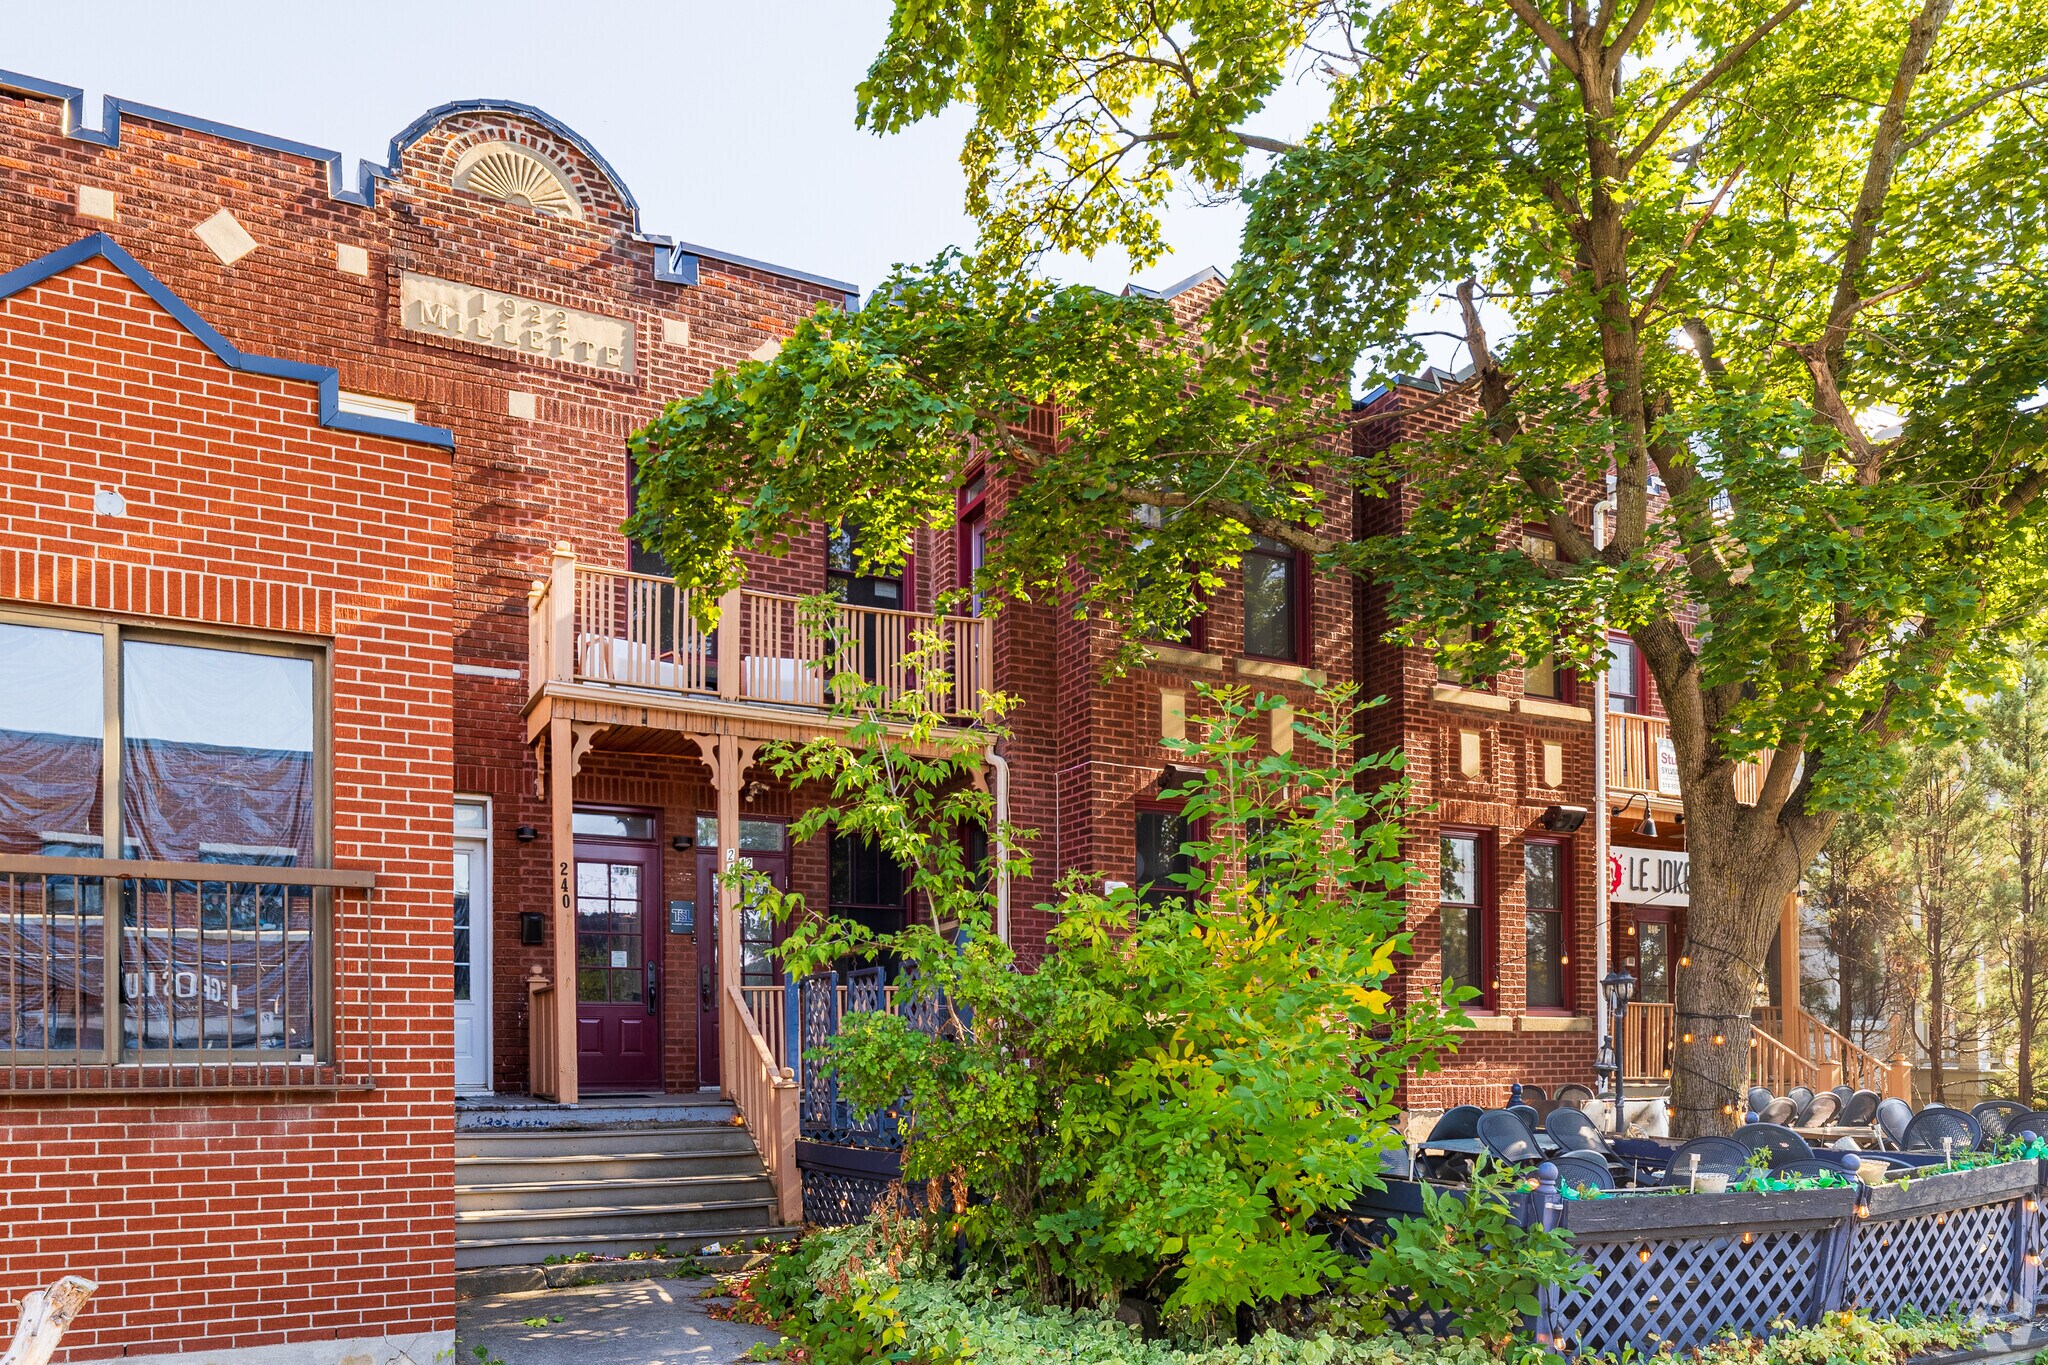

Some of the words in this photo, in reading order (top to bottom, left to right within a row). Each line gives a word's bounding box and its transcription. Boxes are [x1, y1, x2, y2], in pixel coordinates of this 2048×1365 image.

[478, 292, 569, 330] 1922
[417, 299, 623, 367] MILLETTE
[560, 862, 570, 909] 240
[1630, 857, 1650, 891] LE
